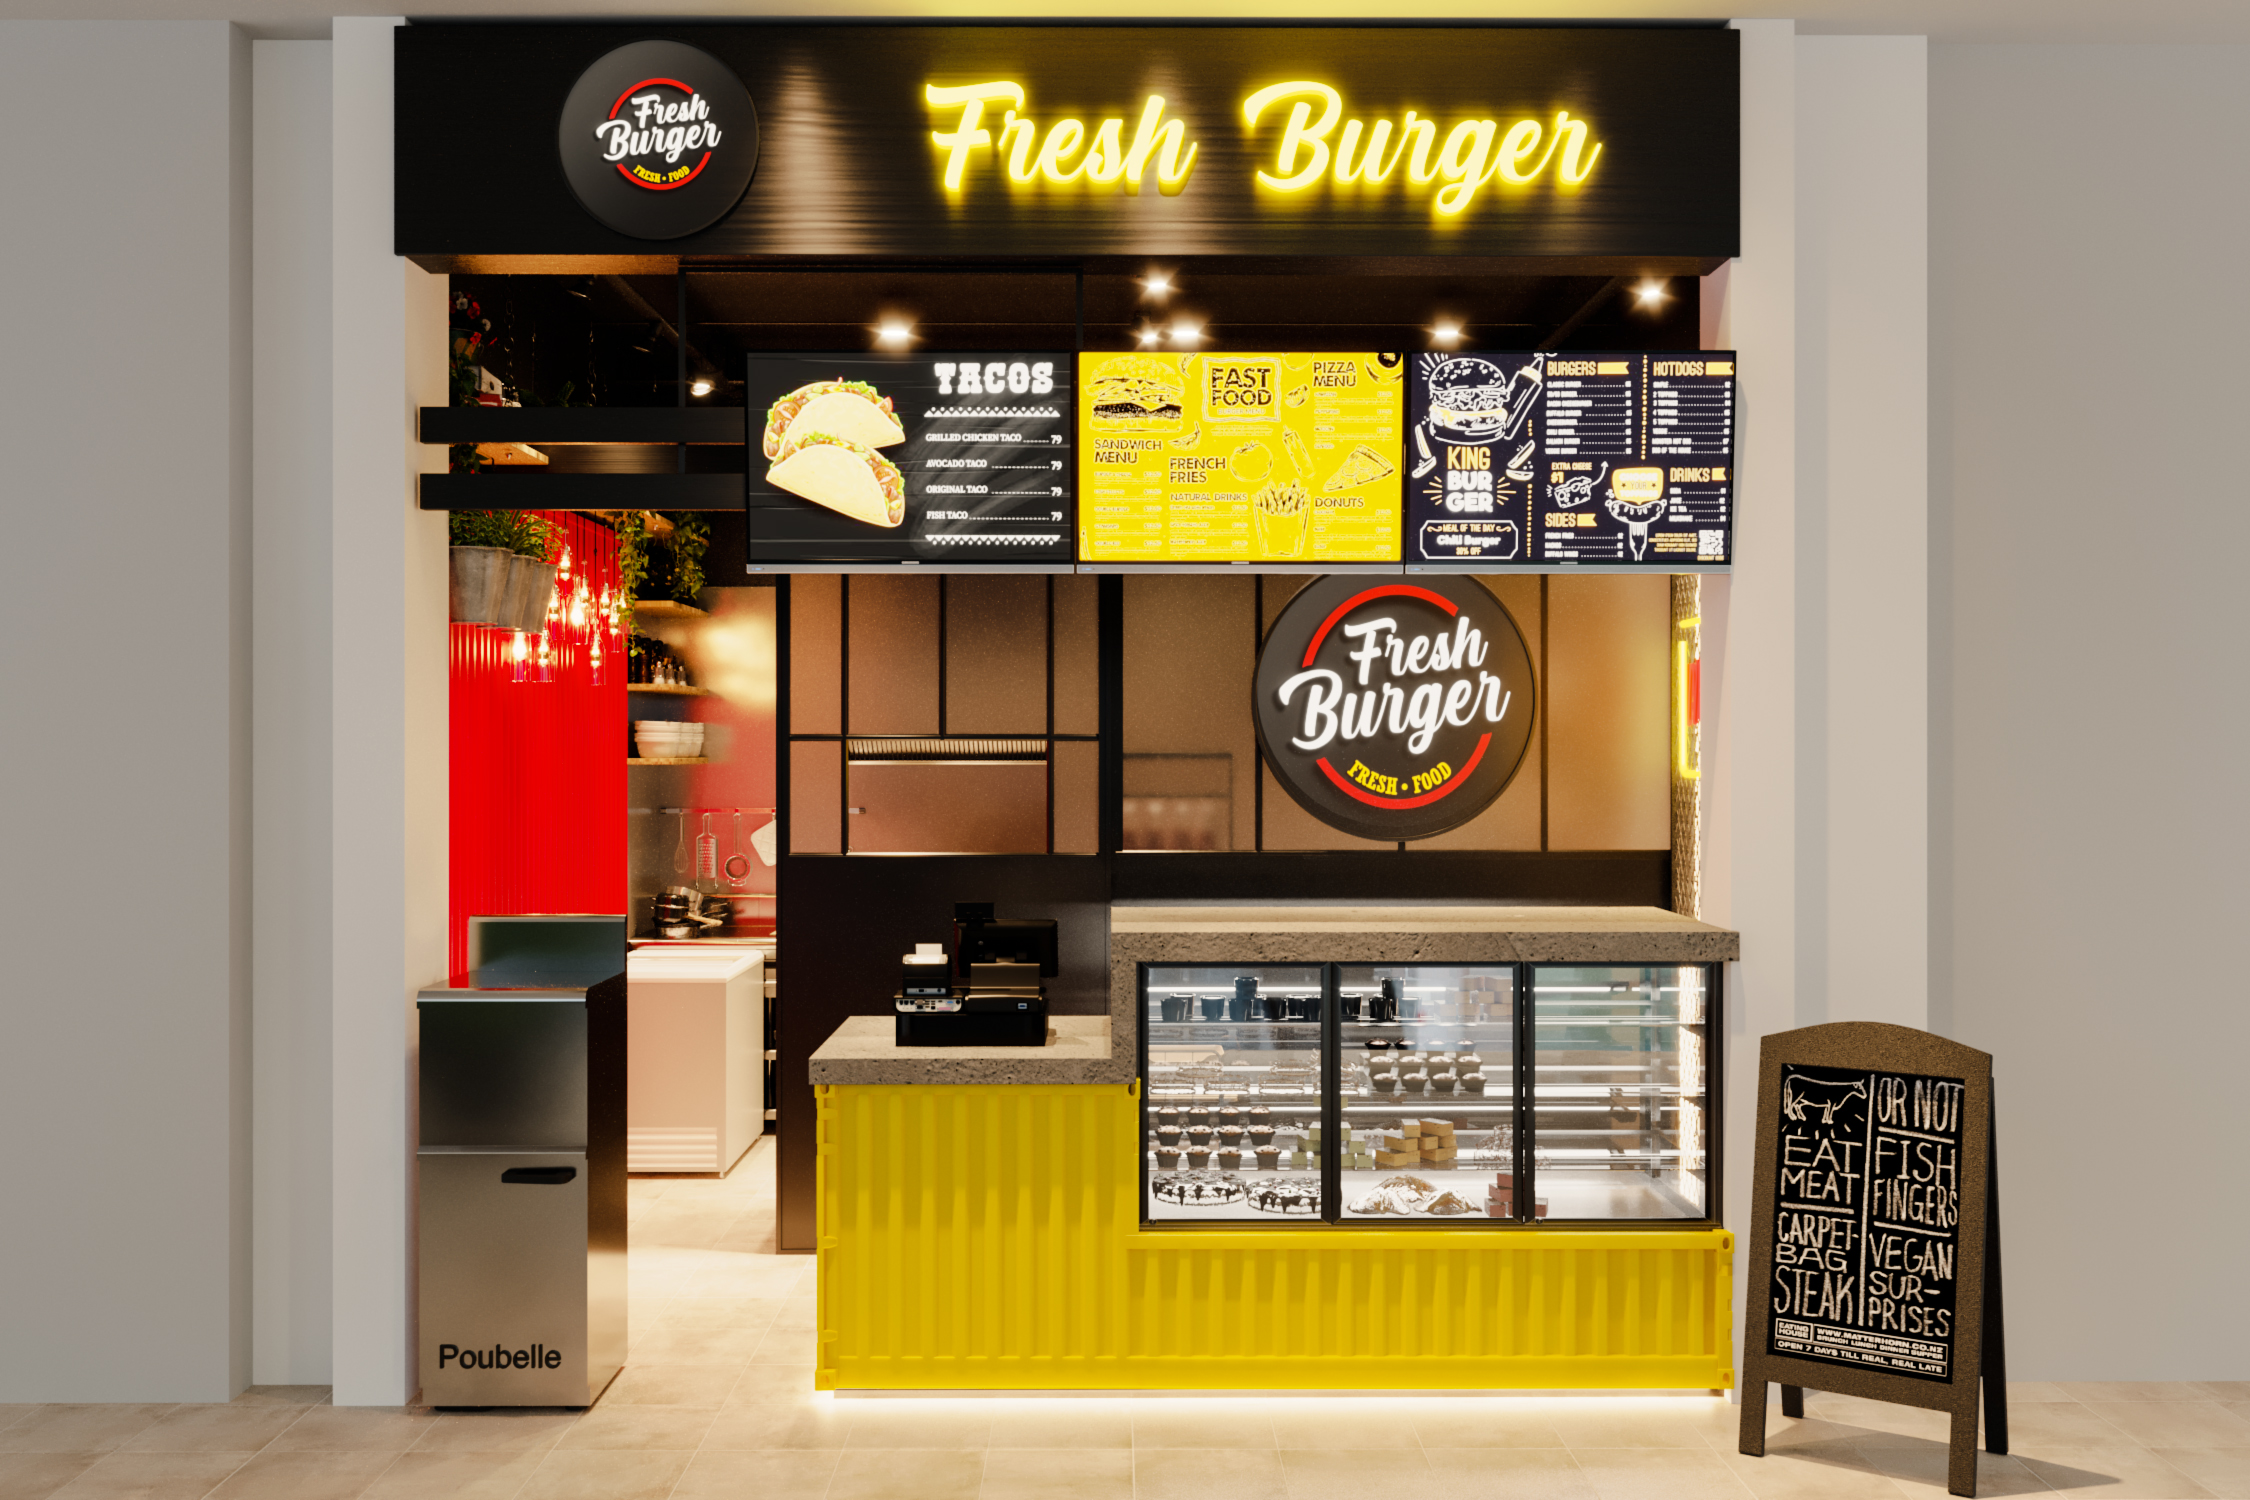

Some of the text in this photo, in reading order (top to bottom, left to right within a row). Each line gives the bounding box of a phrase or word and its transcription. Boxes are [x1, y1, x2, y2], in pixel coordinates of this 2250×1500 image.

[631, 93, 710, 129] Fresh
[596, 119, 722, 164] Burger
[925, 80, 1603, 216] Fresh Burger
[632, 164, 690, 183] FRESH FOOD
[934, 362, 1053, 394] TACOS
[1211, 367, 1271, 388] FAST
[1313, 361, 1356, 374] PIZZA
[1547, 361, 1597, 376] BURGERS
[1653, 361, 1704, 376] HOTDOGS
[1313, 375, 1356, 387] MENU
[1212, 389, 1272, 406] FOOD
[925, 432, 1062, 445] GRILLED CHICKEN TACO 79
[1094, 439, 1162, 450] SANDWICH
[926, 459, 1062, 471] AVOCADO TACO 79
[1094, 451, 1138, 464] MENU
[1170, 457, 1226, 470] FRENCH
[1447, 446, 1491, 470] KING
[1551, 462, 1593, 470] EXTRA CHEESE
[1170, 471, 1207, 483] FRIES
[1447, 470, 1493, 491] BUR
[1550, 471, 1565, 484] $1
[1670, 467, 1710, 482] DRINKS
[926, 485, 1062, 497] ORIGINAL TACO 79
[1170, 493, 1211, 501] NATURAL
[1213, 493, 1247, 501] DRINKS
[1315, 497, 1364, 508] DONUTS
[1446, 491, 1494, 513] GER
[926, 510, 1062, 522] FISH TACO 79
[1545, 513, 1576, 527] SIDES
[1442, 524, 1496, 532] MEAL OF THE DAY
[1464, 535, 1502, 548] Burger
[1344, 616, 1488, 685] Fresh
[1278, 669, 1511, 754] Burger
[1346, 759, 1452, 796] FRESH FOOD
[1877, 1077, 1965, 1133] OR NOT
[1784, 1134, 1863, 1173] EAT
[1875, 1136, 1956, 1190] FISH
[1780, 1167, 1861, 1205] MEAT
[1873, 1178, 1958, 1229] FINGERS
[1777, 1211, 1859, 1251] CARPET-
[1775, 1242, 1847, 1274] BAG
[1869, 1232, 1953, 1282] VEGAN
[1773, 1265, 1855, 1325] STEAK
[1868, 1270, 1941, 1303] SUR-
[1778, 1321, 1810, 1333] EATING
[1868, 1296, 1952, 1337] PRISES
[1778, 1329, 1809, 1339] HOUSE
[439, 1344, 562, 1369] Poubelle
[1777, 1340, 1943, 1374] OPEN 7 DAYS TILL REAL, REAL LATE
[1816, 1334, 1943, 1360] BRUNCH LUNCH DINNER SUPPER
